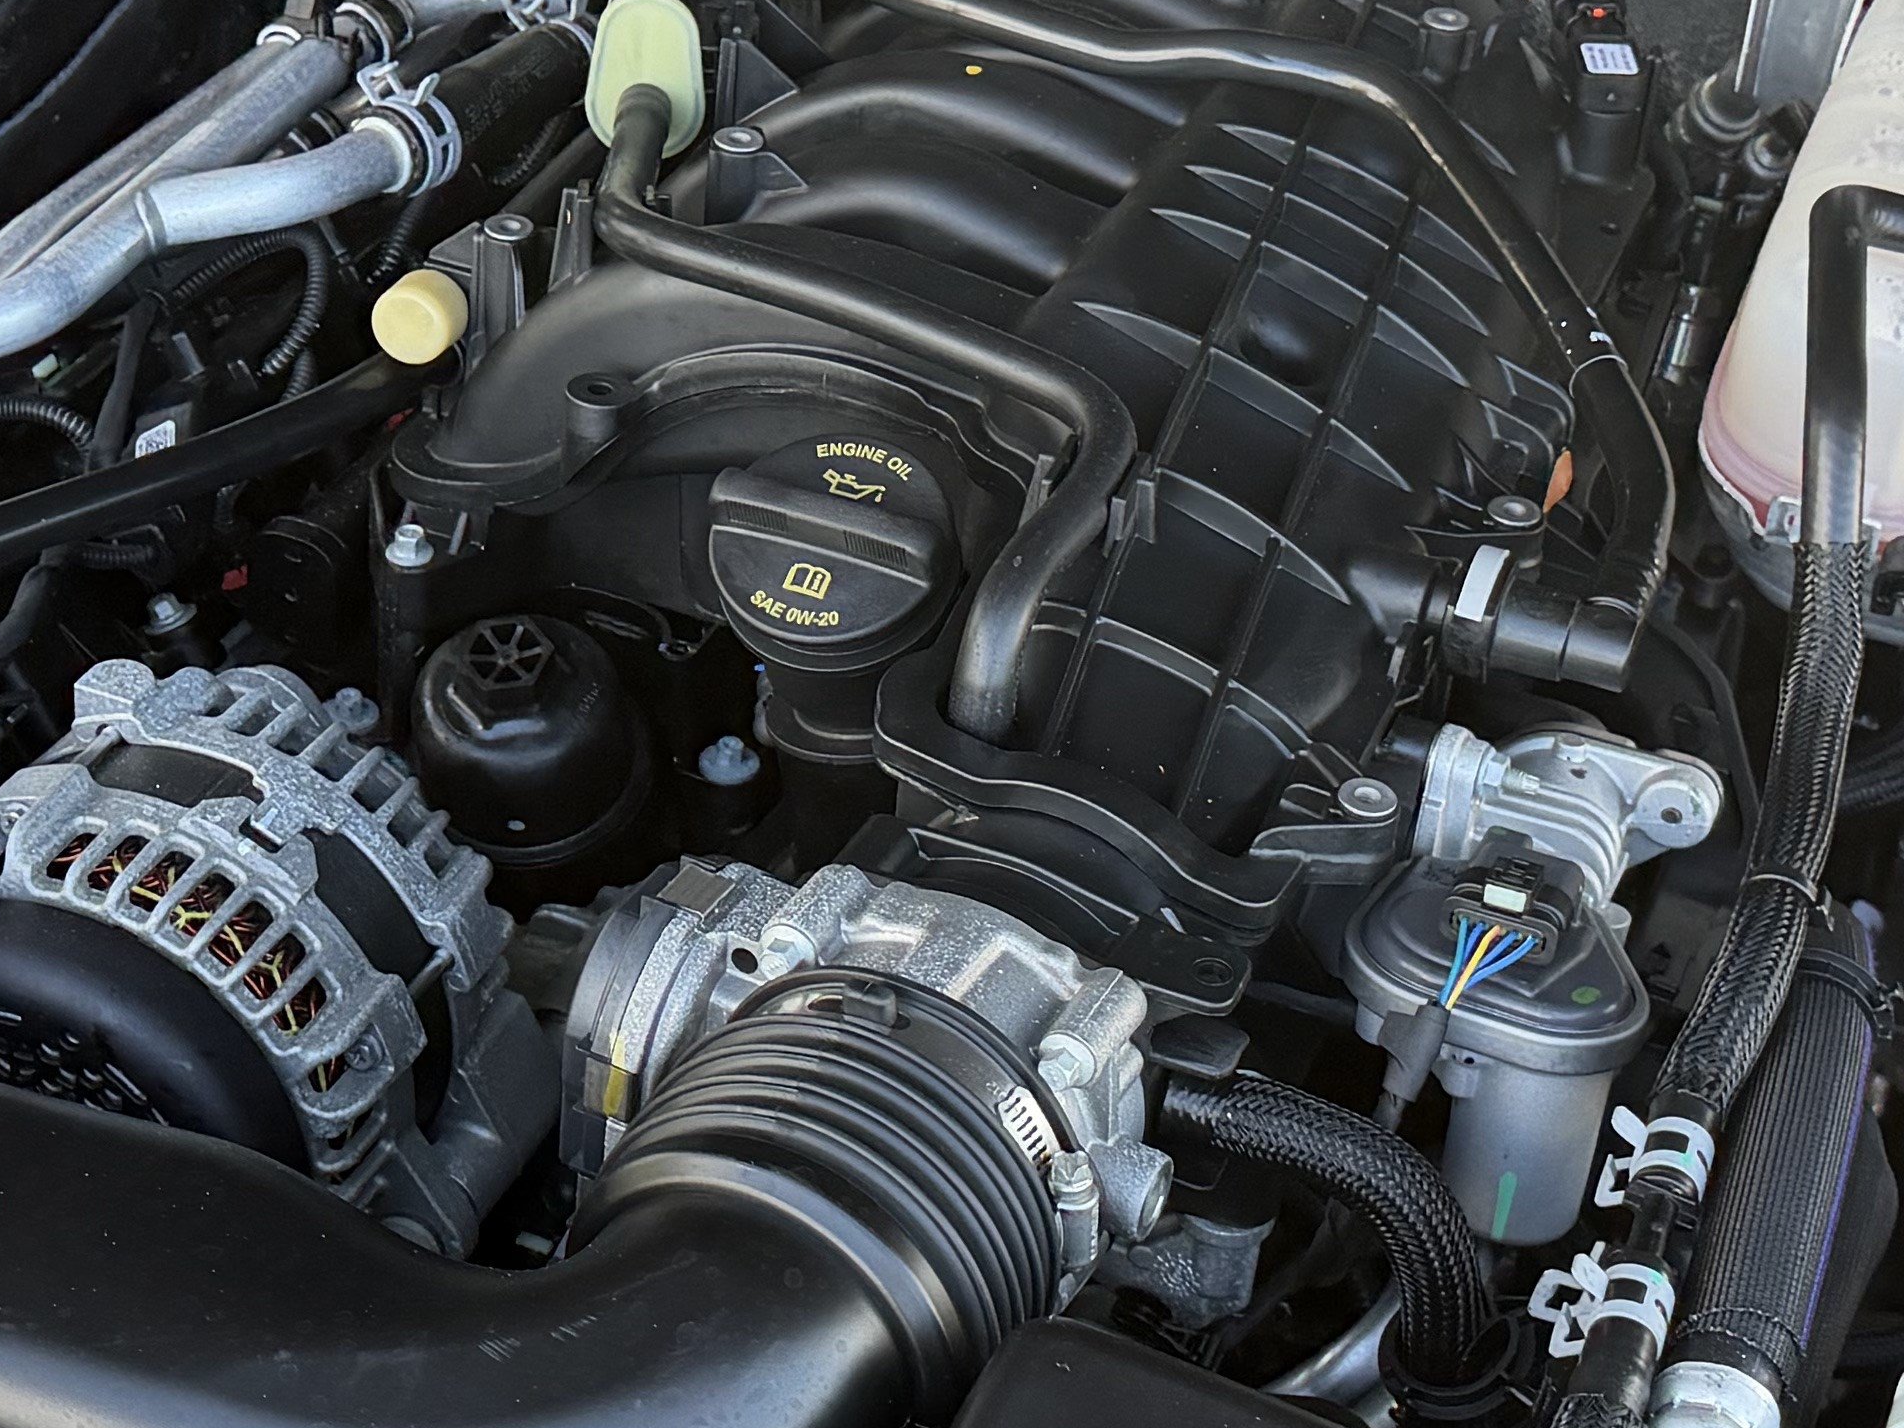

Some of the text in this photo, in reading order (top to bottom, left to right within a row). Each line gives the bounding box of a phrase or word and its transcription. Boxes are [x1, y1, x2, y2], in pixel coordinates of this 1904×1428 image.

[816, 442, 913, 481] ENGINE OIL
[750, 590, 839, 627] SAE 0W-20
